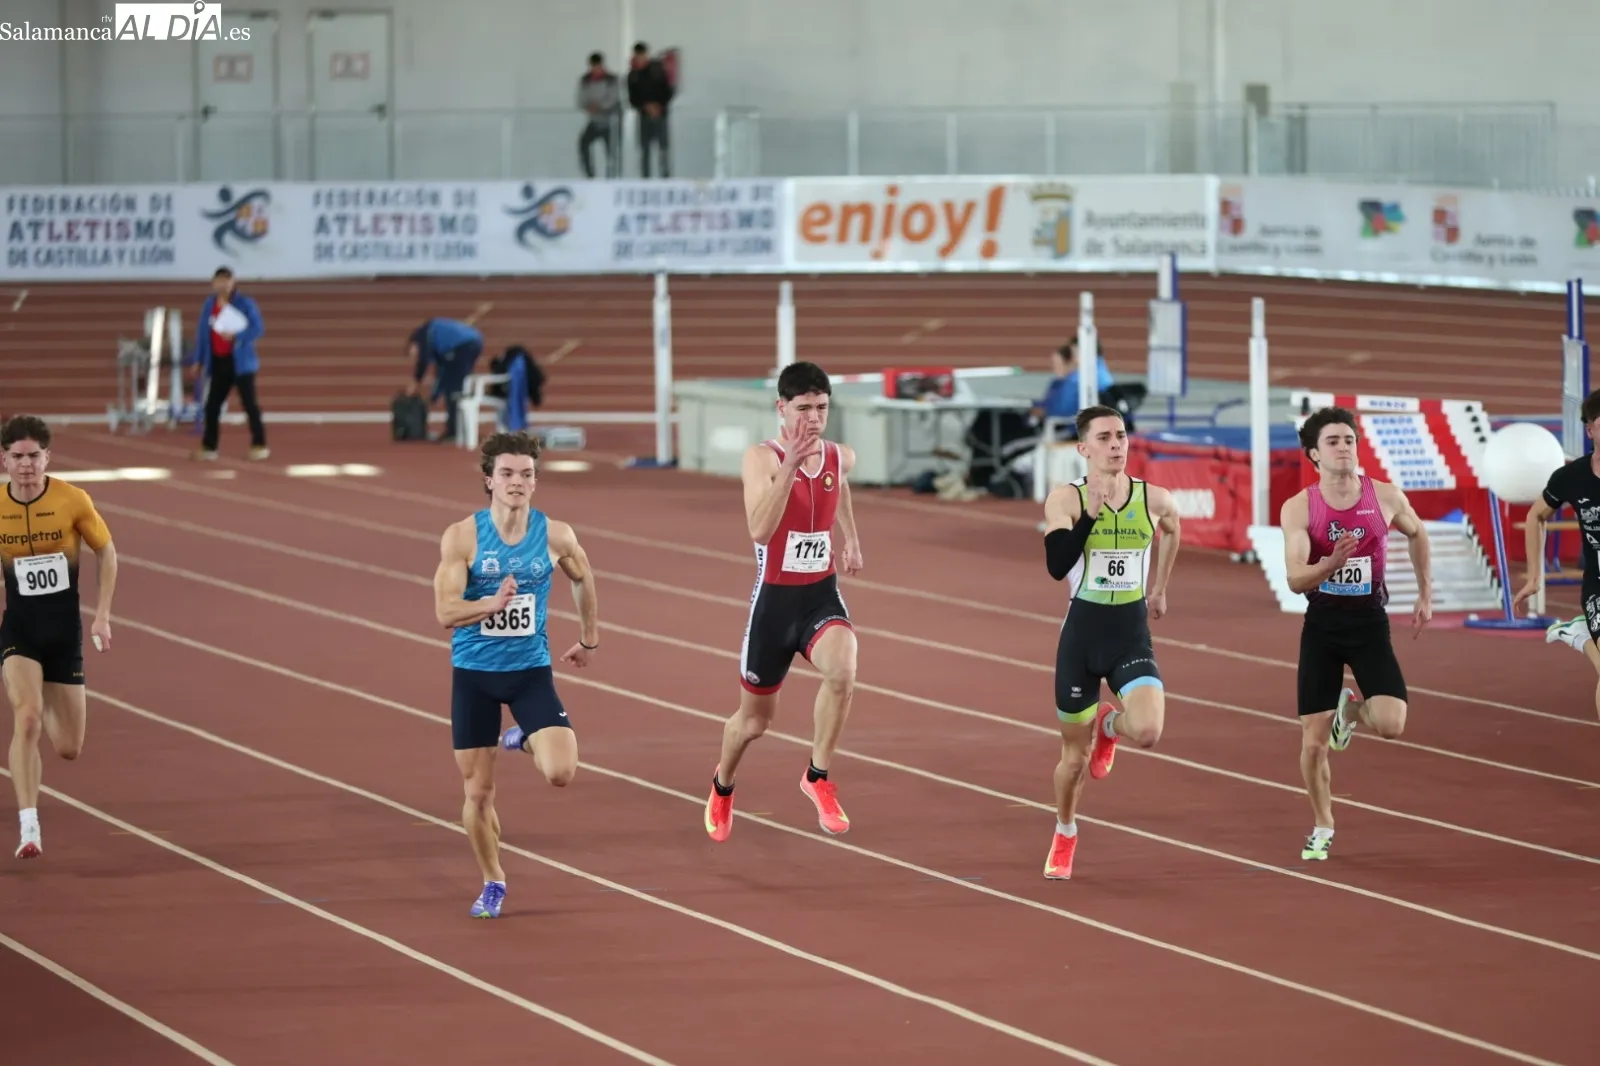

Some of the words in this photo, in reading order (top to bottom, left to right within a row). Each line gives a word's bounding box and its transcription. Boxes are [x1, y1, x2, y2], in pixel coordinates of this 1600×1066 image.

[7, 193, 137, 215] FEDERACIÓN
[150, 192, 172, 214] DE
[313, 188, 441, 209] FEDERACIÓN
[452, 188, 477, 209] DE
[8, 218, 175, 243] ATLETISMO
[314, 213, 478, 237] ATLETISMO
[614, 208, 774, 234] ATLETISMO
[799, 184, 1007, 260] enjoy!
[8, 247, 28, 268] DE
[33, 247, 112, 267] CASTILLA
[129, 245, 175, 266] LEÓN
[314, 242, 334, 263] DE
[0, 529, 63, 546] Norpetrol
[795, 541, 826, 559] 1712
[26, 568, 58, 590] 900
[1108, 560, 1125, 576] 66
[485, 607, 531, 631] 3365
